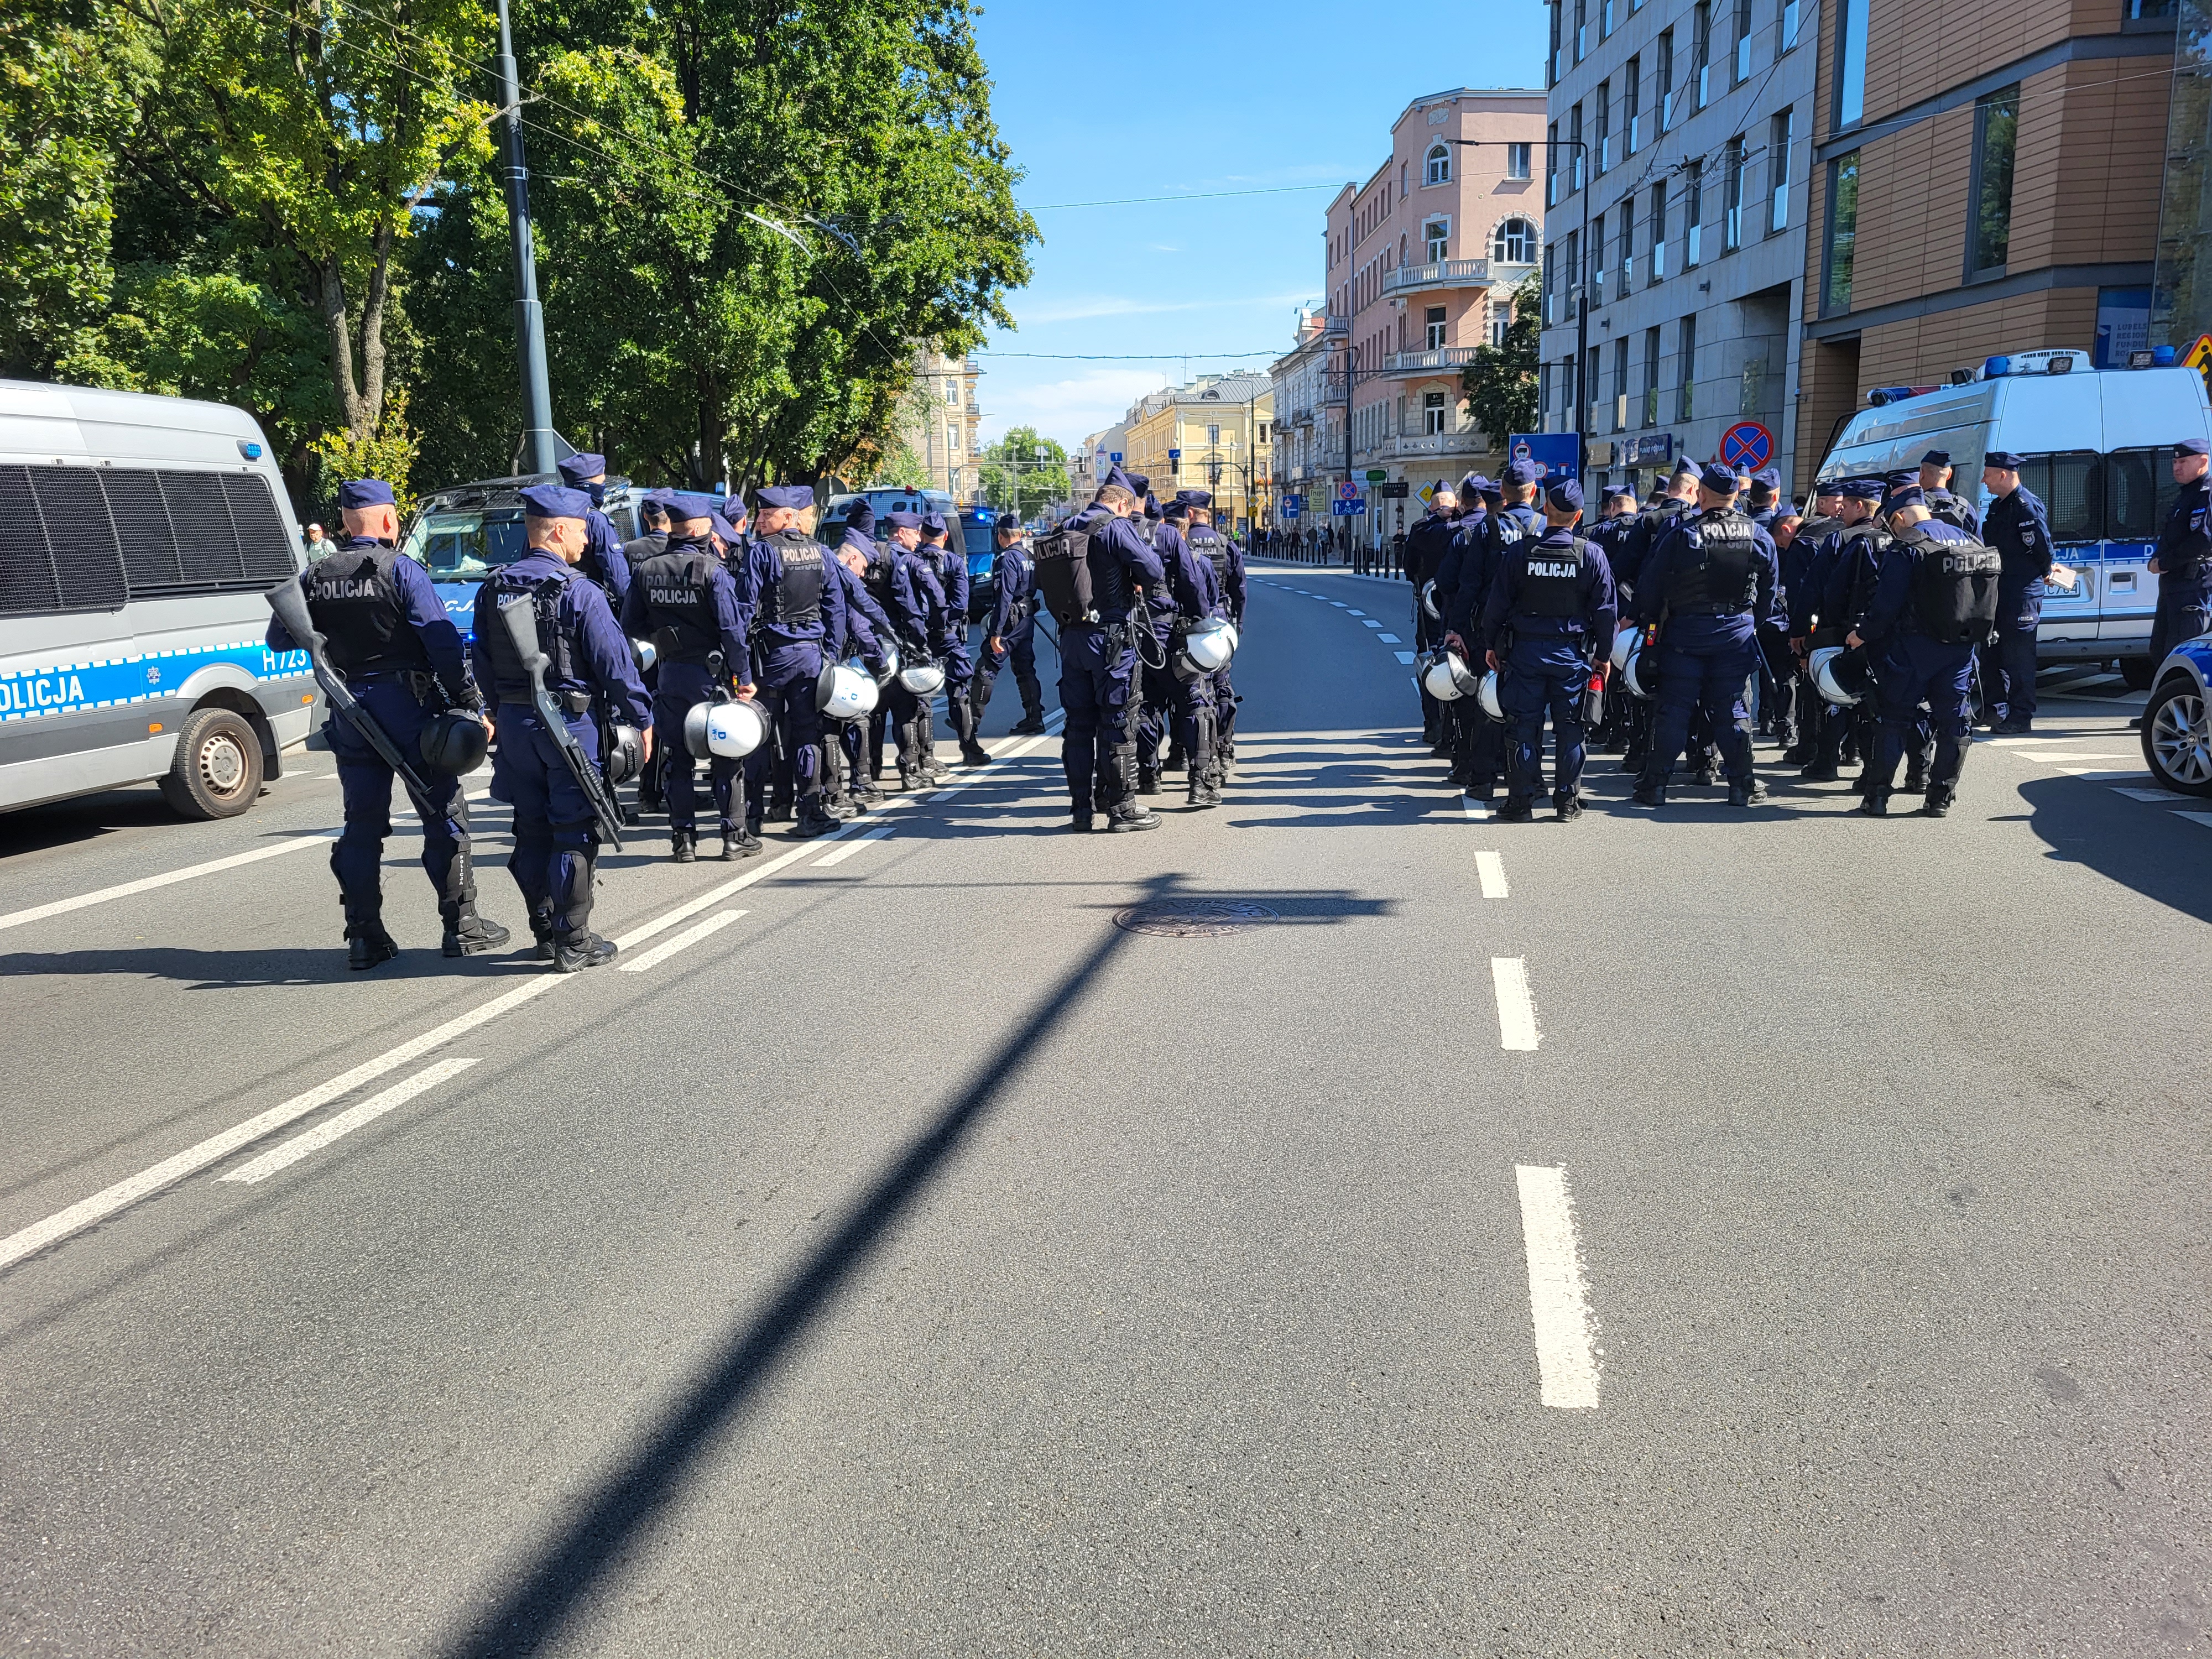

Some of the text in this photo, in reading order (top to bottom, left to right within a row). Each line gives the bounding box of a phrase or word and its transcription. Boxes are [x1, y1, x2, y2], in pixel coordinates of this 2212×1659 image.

[1703, 524, 1751, 537] POLICJA
[782, 547, 821, 562] POLICJA
[1035, 539, 1070, 560] OLICJA
[1527, 562, 1576, 578] POLICJA
[1943, 554, 2001, 573] POLICJA
[316, 578, 375, 601] POLICJA
[650, 589, 698, 604] POLICJA
[0, 675, 85, 712] OLICJA
[717, 732, 727, 740] D
